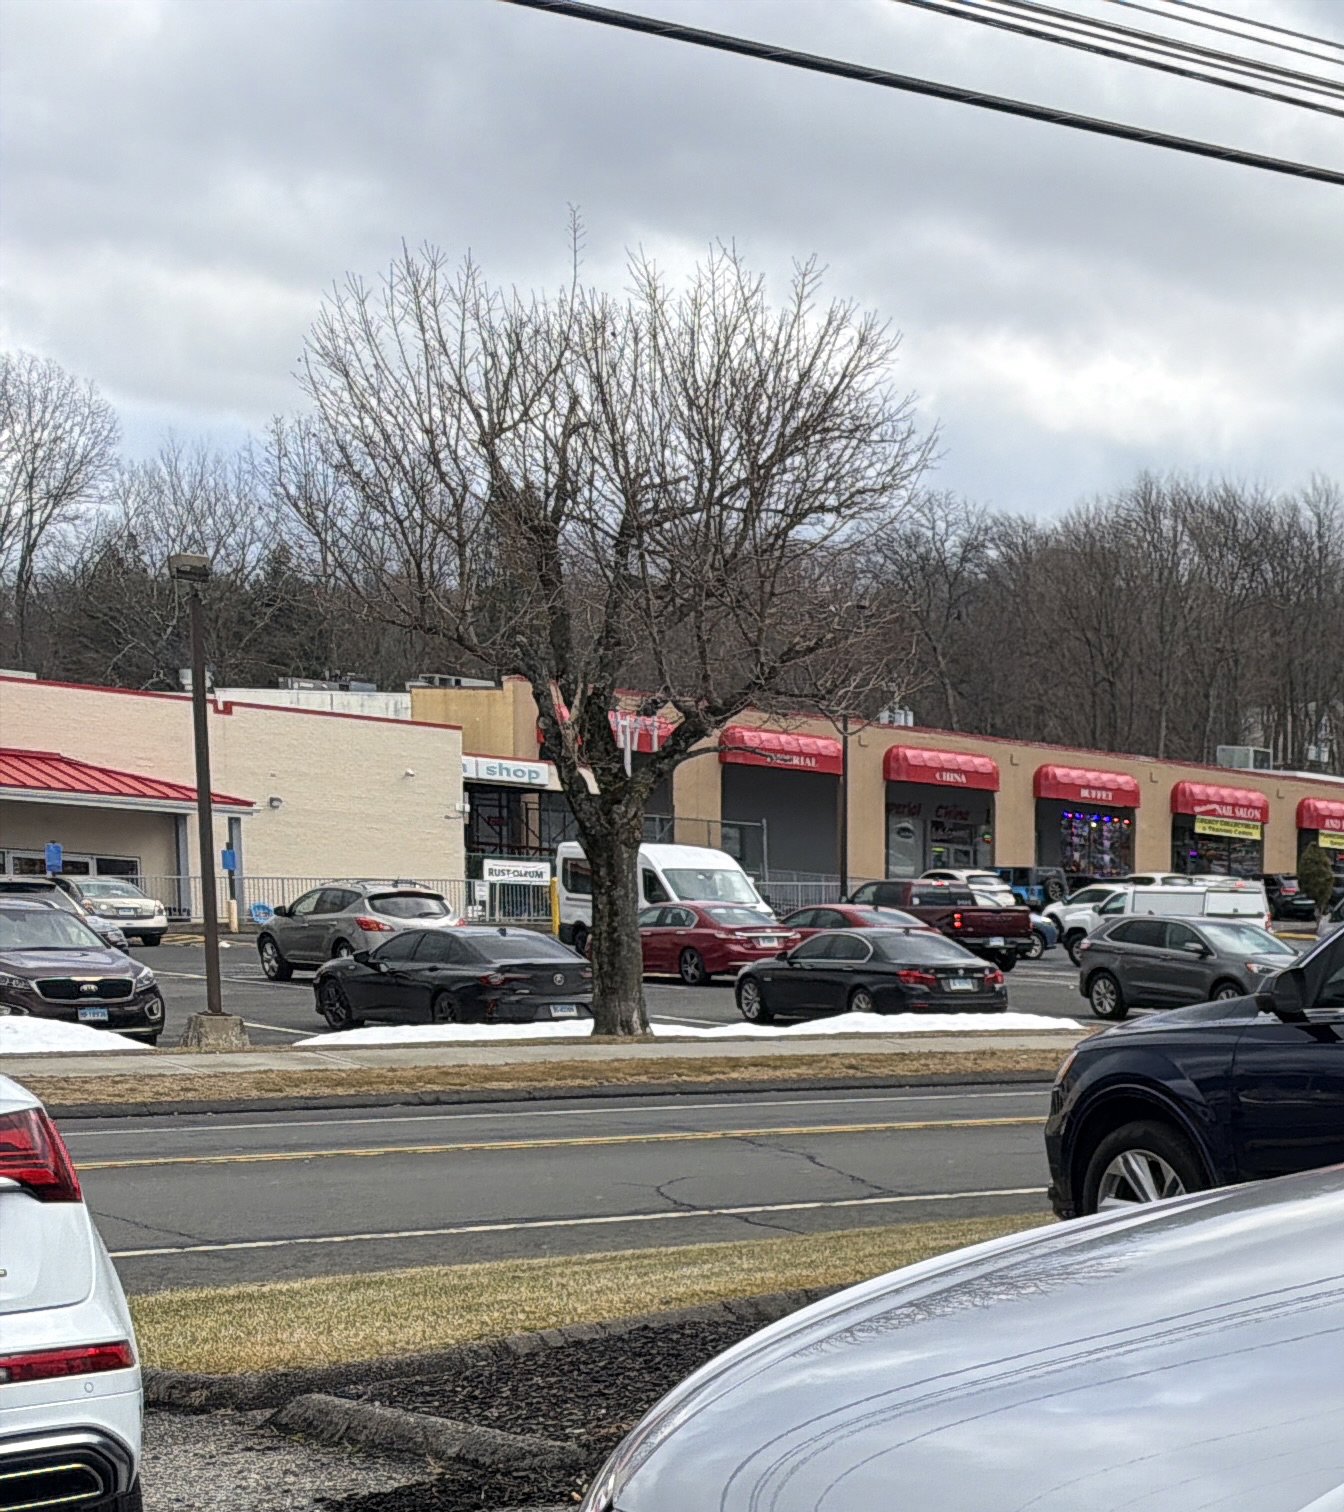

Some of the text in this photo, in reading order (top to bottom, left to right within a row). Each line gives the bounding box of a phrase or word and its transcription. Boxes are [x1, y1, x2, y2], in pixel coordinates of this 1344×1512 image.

[486, 763, 540, 783] shop
[935, 771, 967, 783] CHINA
[1216, 804, 1262, 820] NAIL SALON
